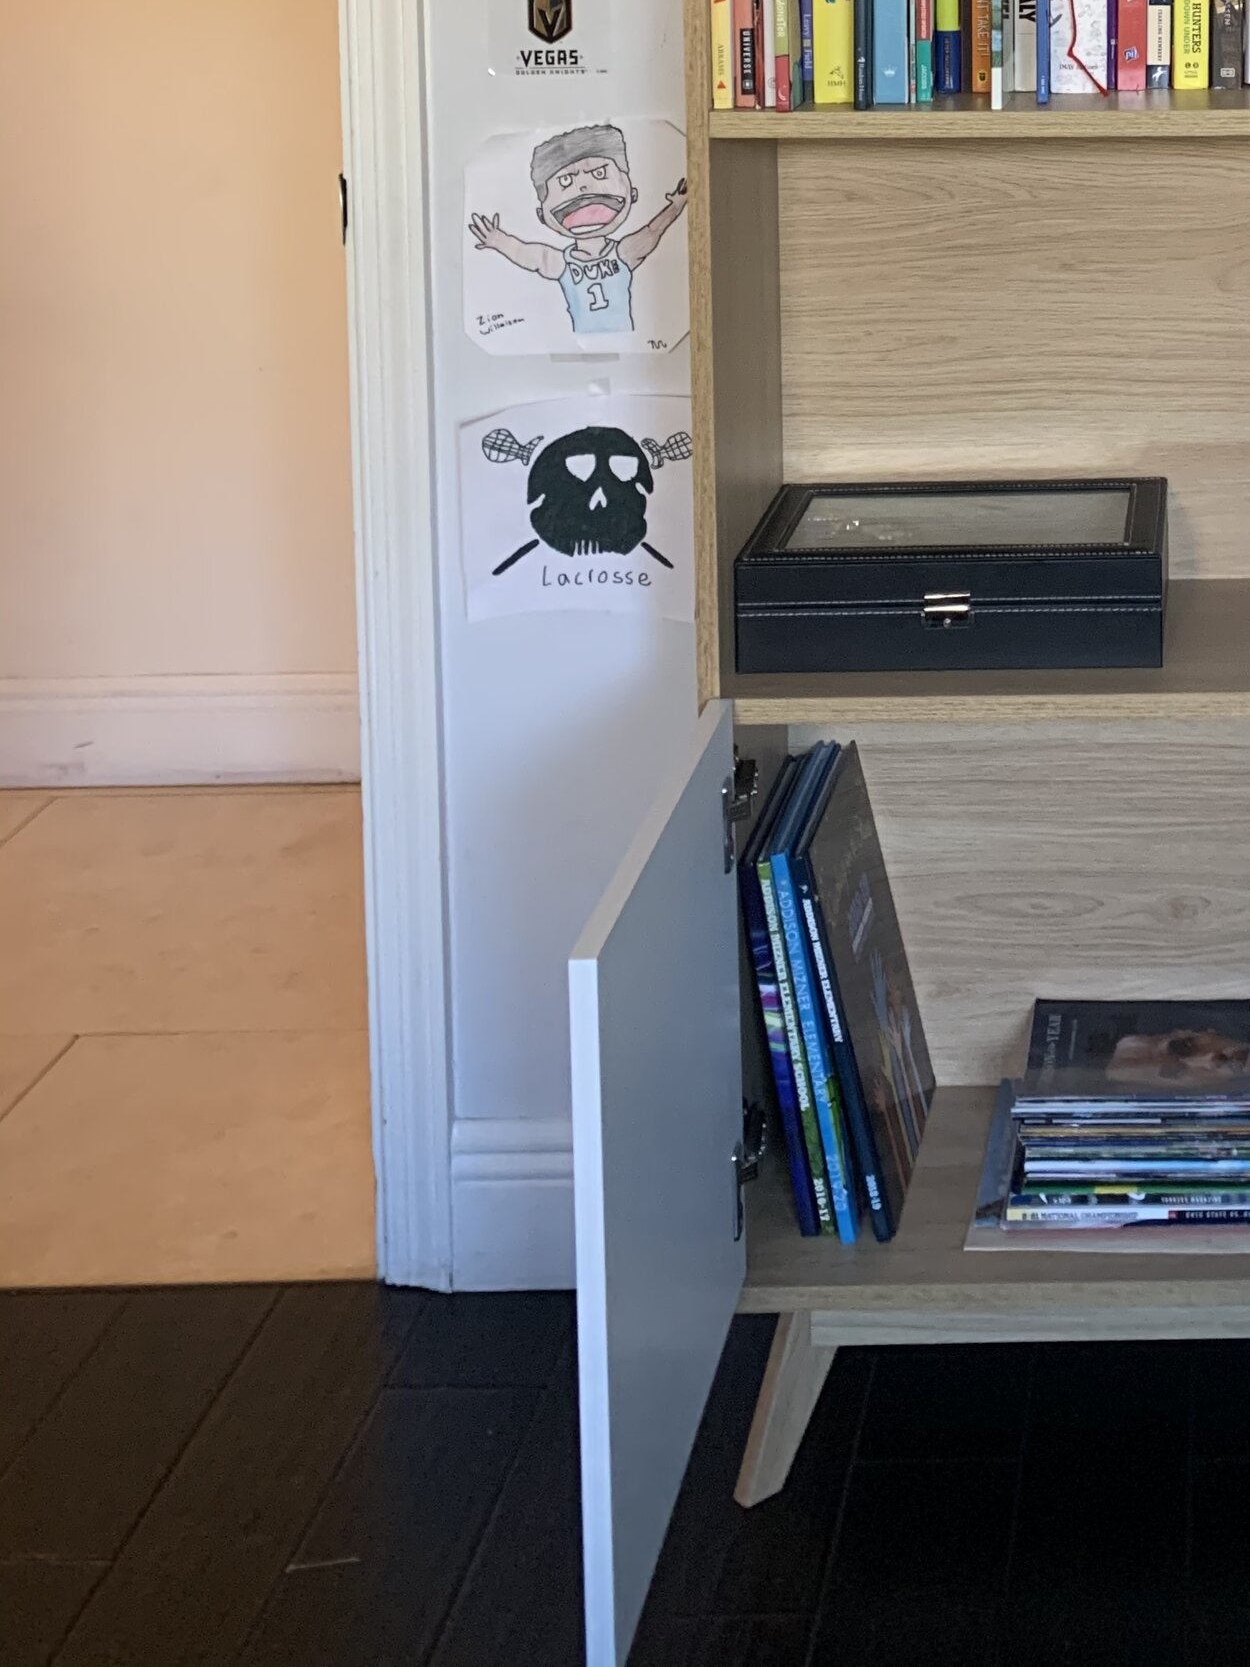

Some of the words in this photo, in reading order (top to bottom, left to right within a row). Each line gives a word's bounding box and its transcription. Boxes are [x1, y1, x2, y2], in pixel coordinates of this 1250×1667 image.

[977, 14, 989, 38] TAKE
[1183, 26, 1191, 54] UNDER
[1191, 2, 1202, 53] HUNTERS
[519, 50, 579, 67] VEGAS
[742, 30, 752, 74] UNIVERSE
[977, 42, 989, 58] IT!
[567, 259, 620, 285] DUKE
[587, 282, 609, 312] 1
[476, 313, 504, 326] Zion
[542, 565, 652, 587] Lacrosse
[777, 890, 798, 954] ADDISON
[787, 959, 810, 1011] MIZNER
[802, 898, 819, 941] ADDISON
[819, 979, 843, 1043] ELEMENTARY
[761, 878, 777, 931] ADDISON
[777, 982, 801, 1060] ELEMENTARY
[793, 1063, 810, 1111] SCHOOL
[803, 1021, 826, 1103] ELEMENTARY
[813, 1177, 830, 1221] 2016-17
